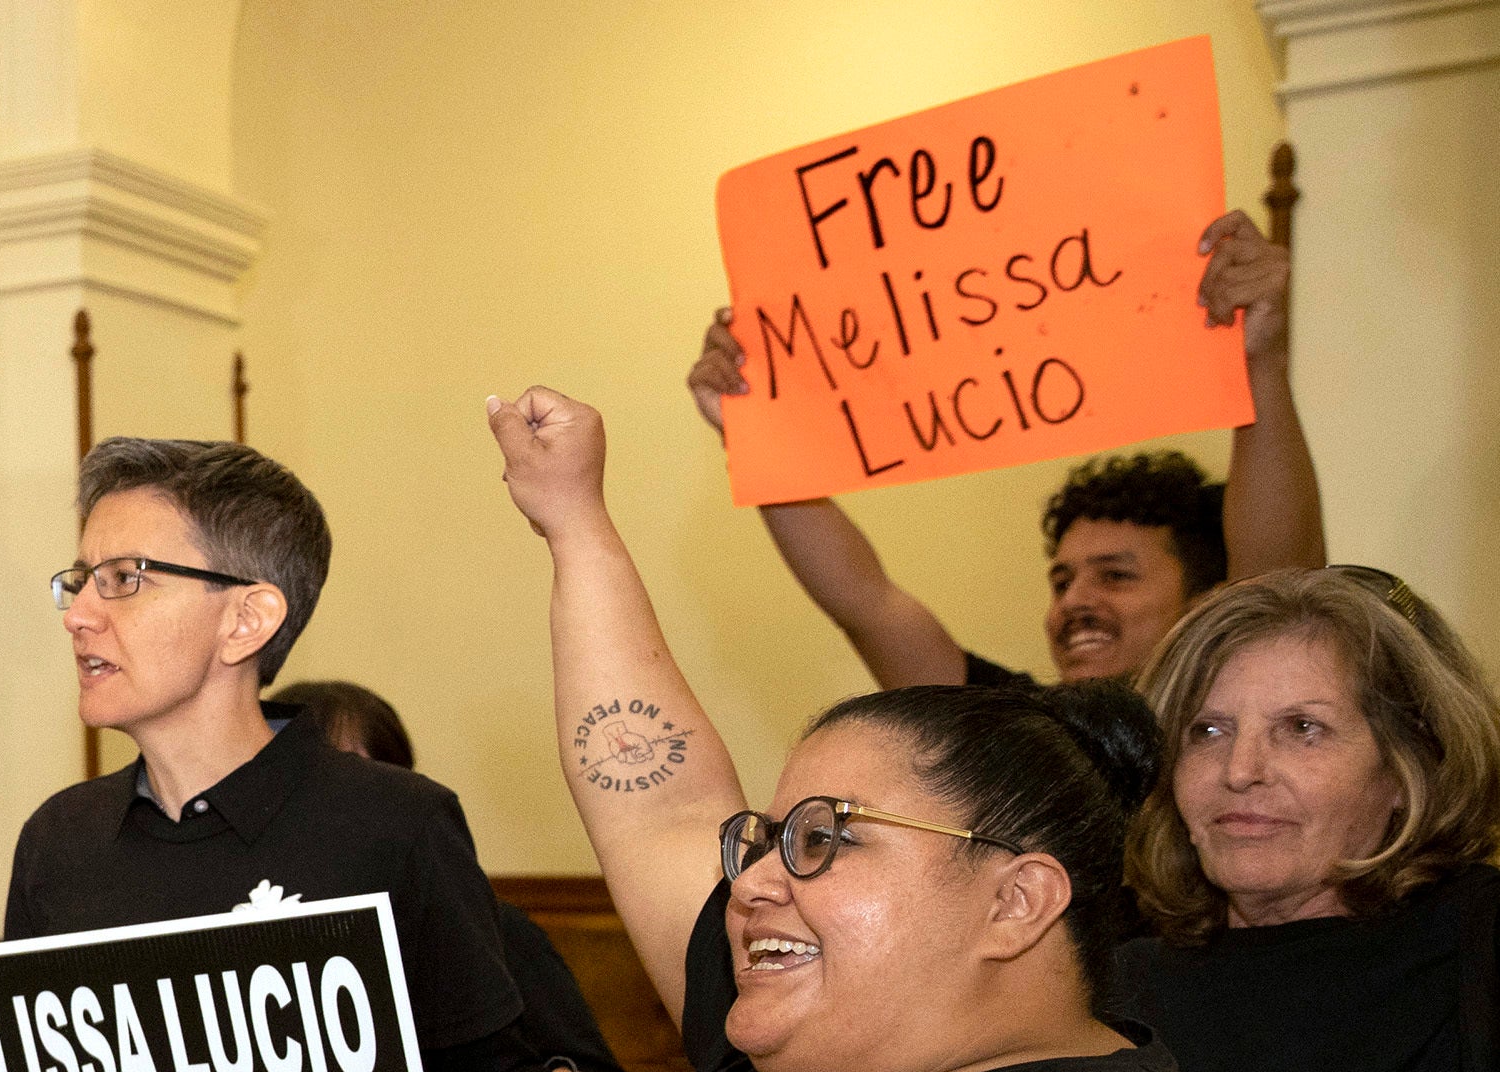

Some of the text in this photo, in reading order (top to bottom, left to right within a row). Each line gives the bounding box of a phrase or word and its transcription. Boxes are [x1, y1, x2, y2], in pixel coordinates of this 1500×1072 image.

[795, 134, 1005, 269] Free
[756, 227, 1122, 400] Melissa
[839, 347, 1084, 477] Lucio
[574, 699, 661, 749] NO PEACE
[587, 738, 687, 792] NO JUSTICE
